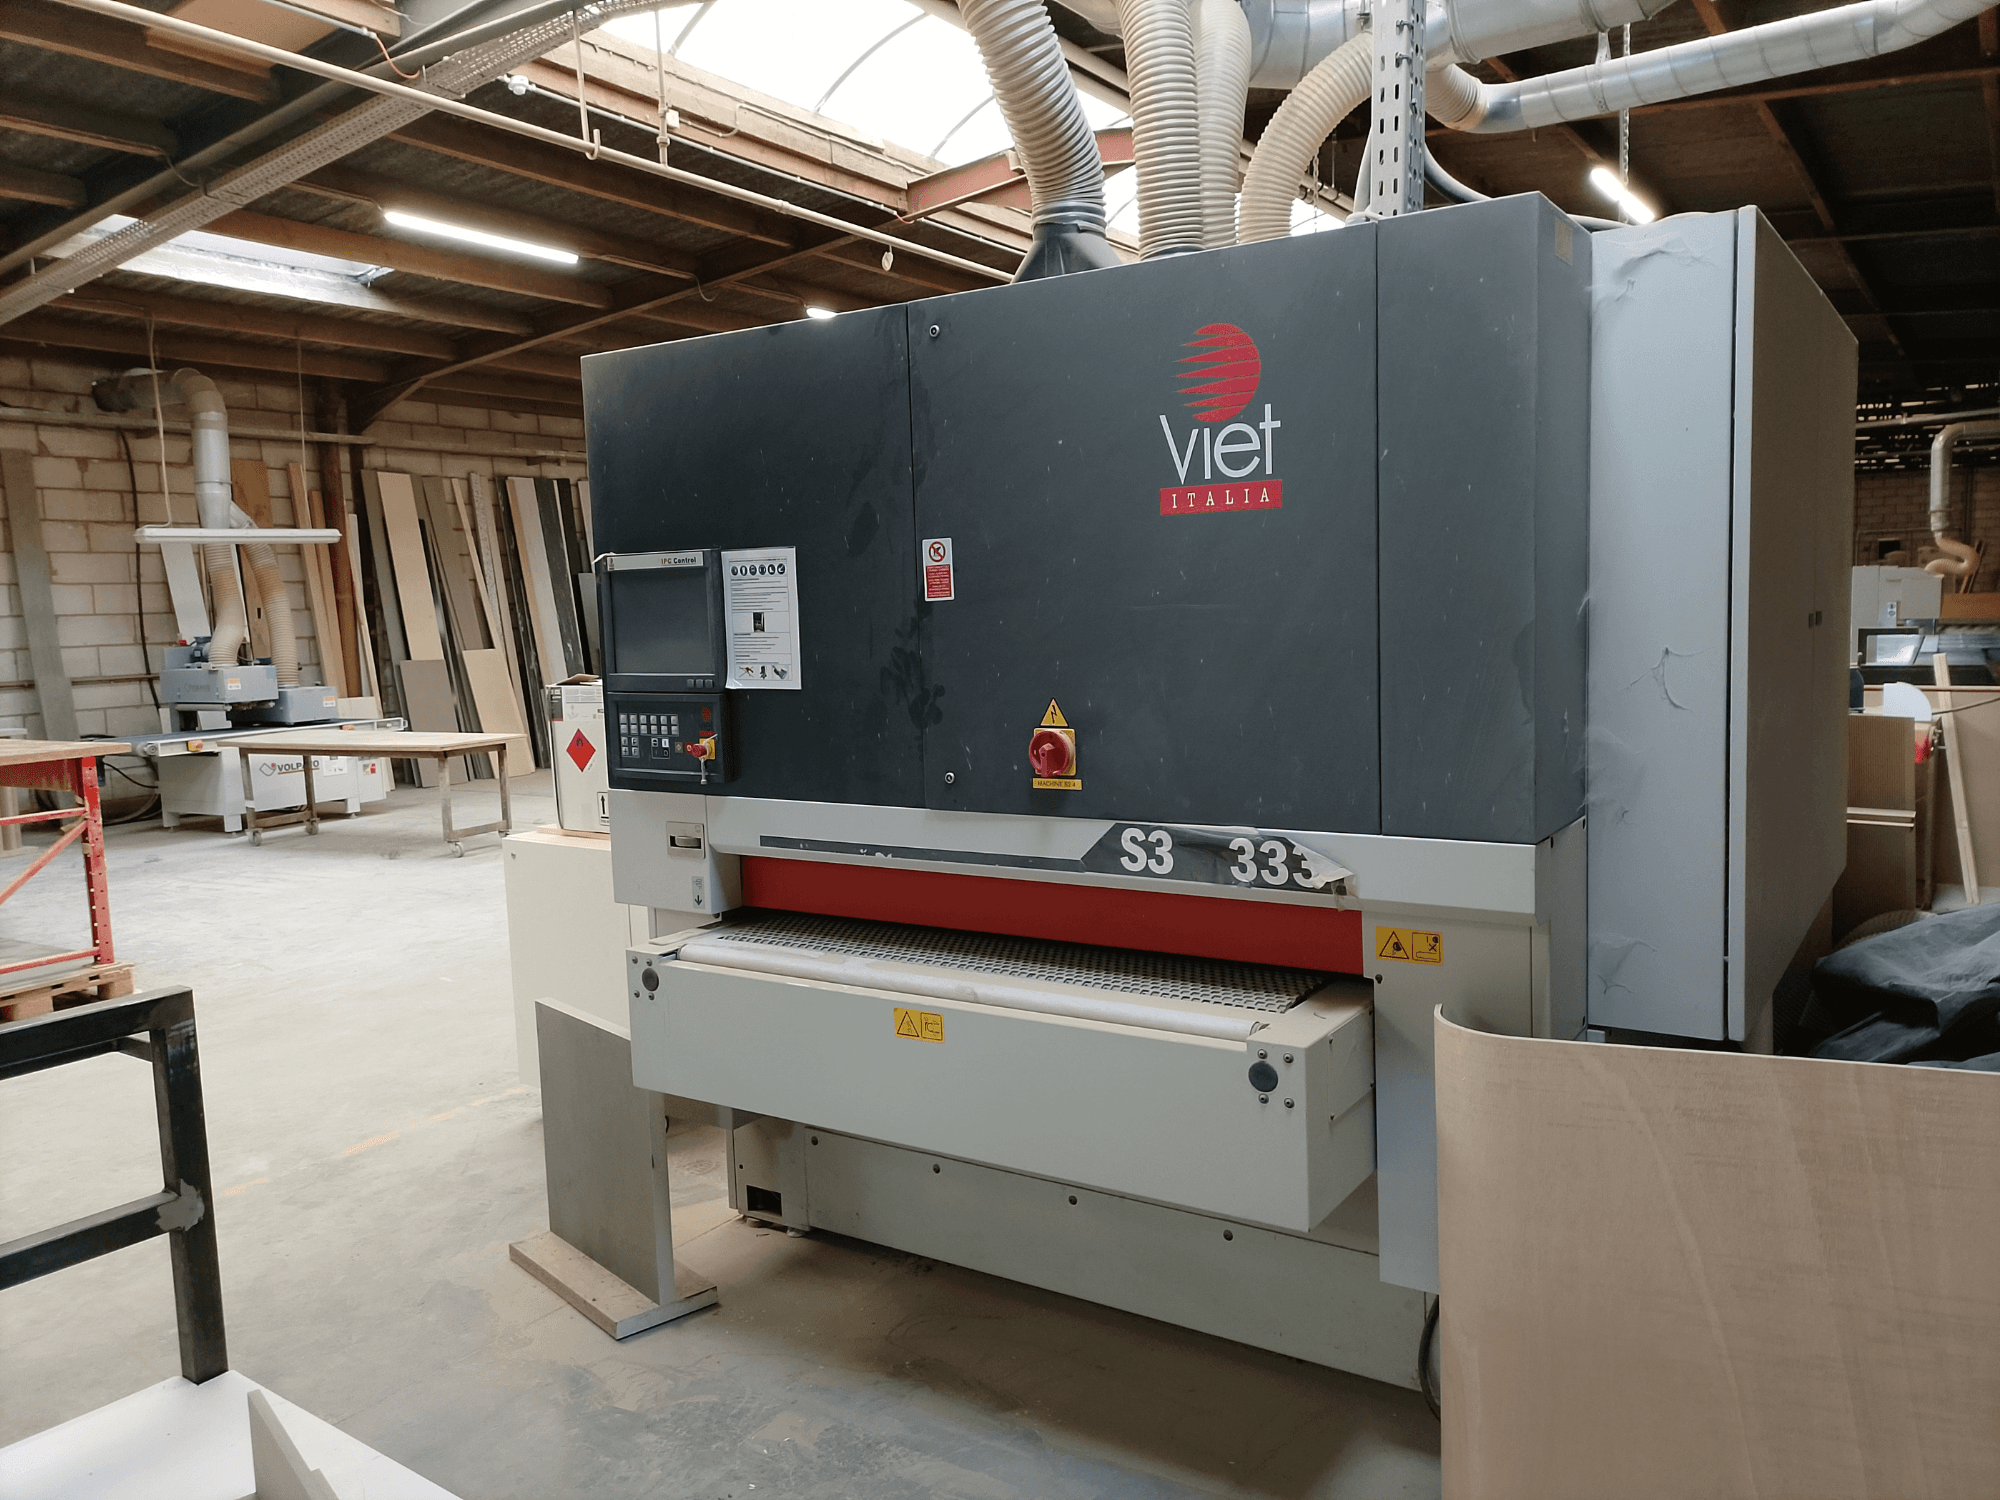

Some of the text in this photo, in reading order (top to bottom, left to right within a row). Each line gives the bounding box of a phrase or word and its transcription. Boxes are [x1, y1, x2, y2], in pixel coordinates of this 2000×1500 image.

[1172, 487, 1270, 508] ITALIA
[277, 760, 320, 771] VOLPO
[1120, 827, 1174, 875] S3
